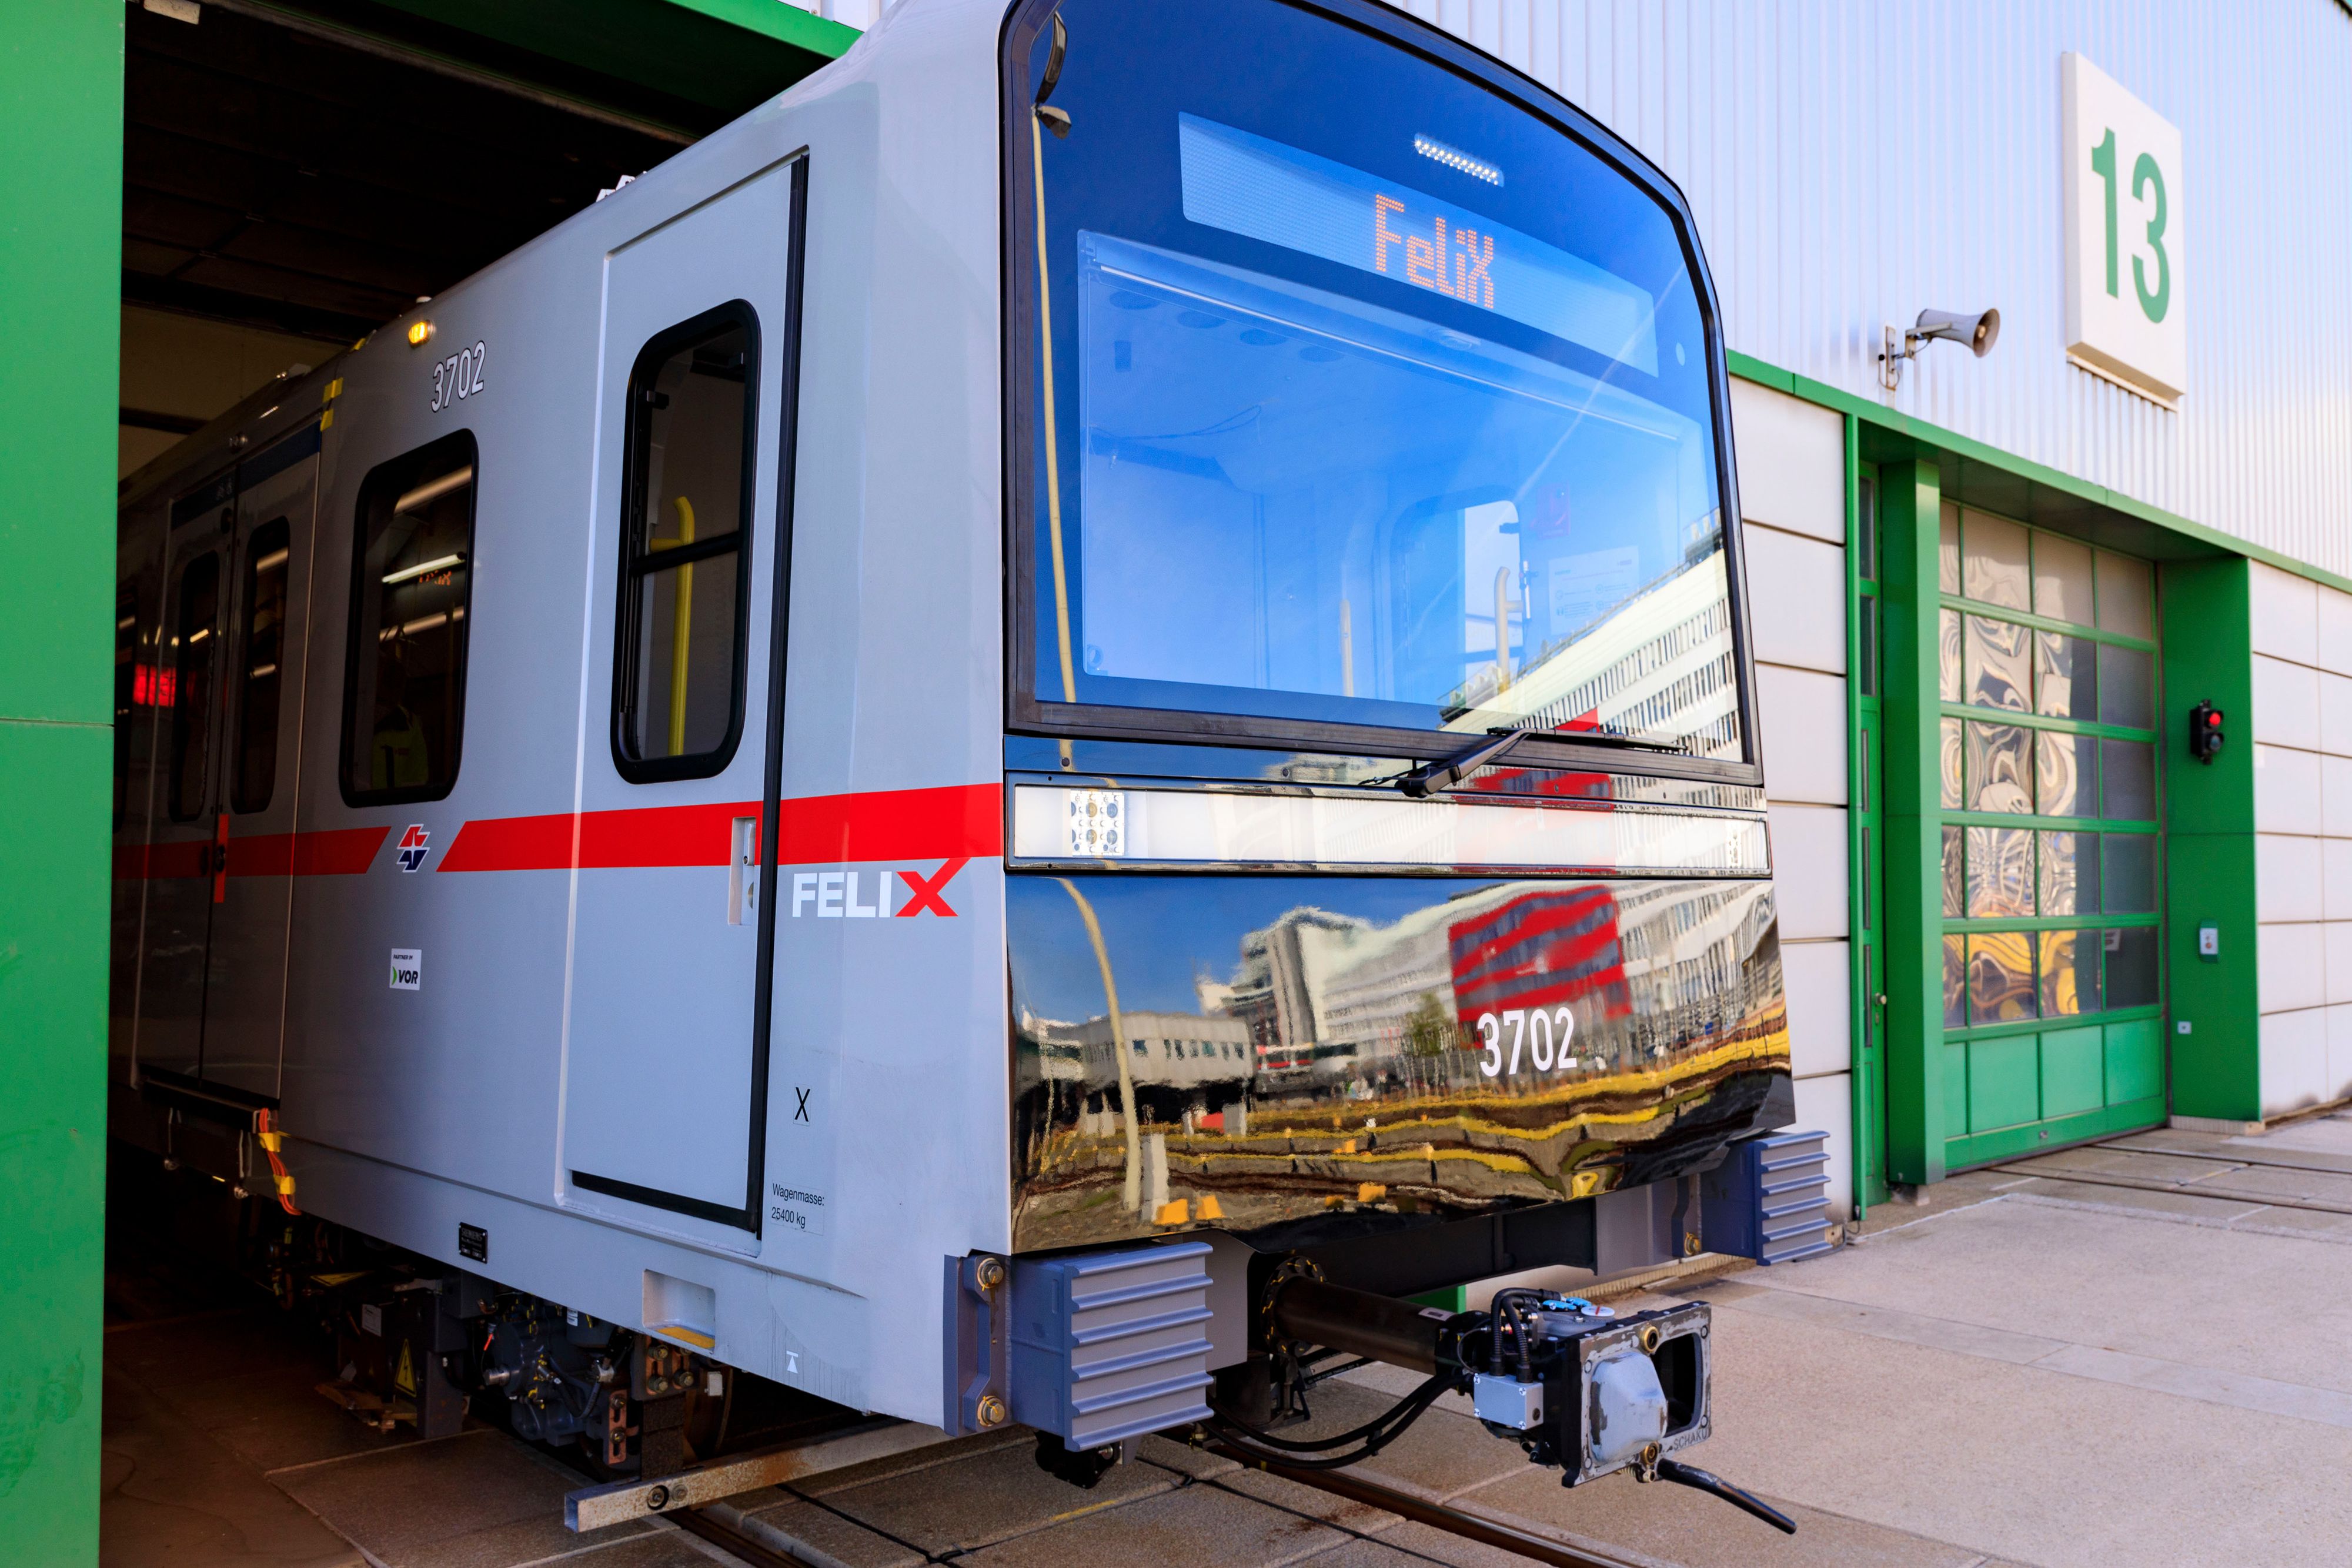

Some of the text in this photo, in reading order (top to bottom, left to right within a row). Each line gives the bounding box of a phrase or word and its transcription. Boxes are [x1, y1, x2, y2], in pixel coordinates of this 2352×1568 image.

[2092, 126, 2170, 324] 13
[431, 340, 486, 413] 3702
[792, 857, 971, 918] FELIX
[399, 969, 418, 984] VOR
[1477, 1007, 1577, 1076] 3702
[794, 1086, 810, 1122] X
[771, 1206, 806, 1229] 25400 kg
[773, 1183, 824, 1206] Wagenmasse:
